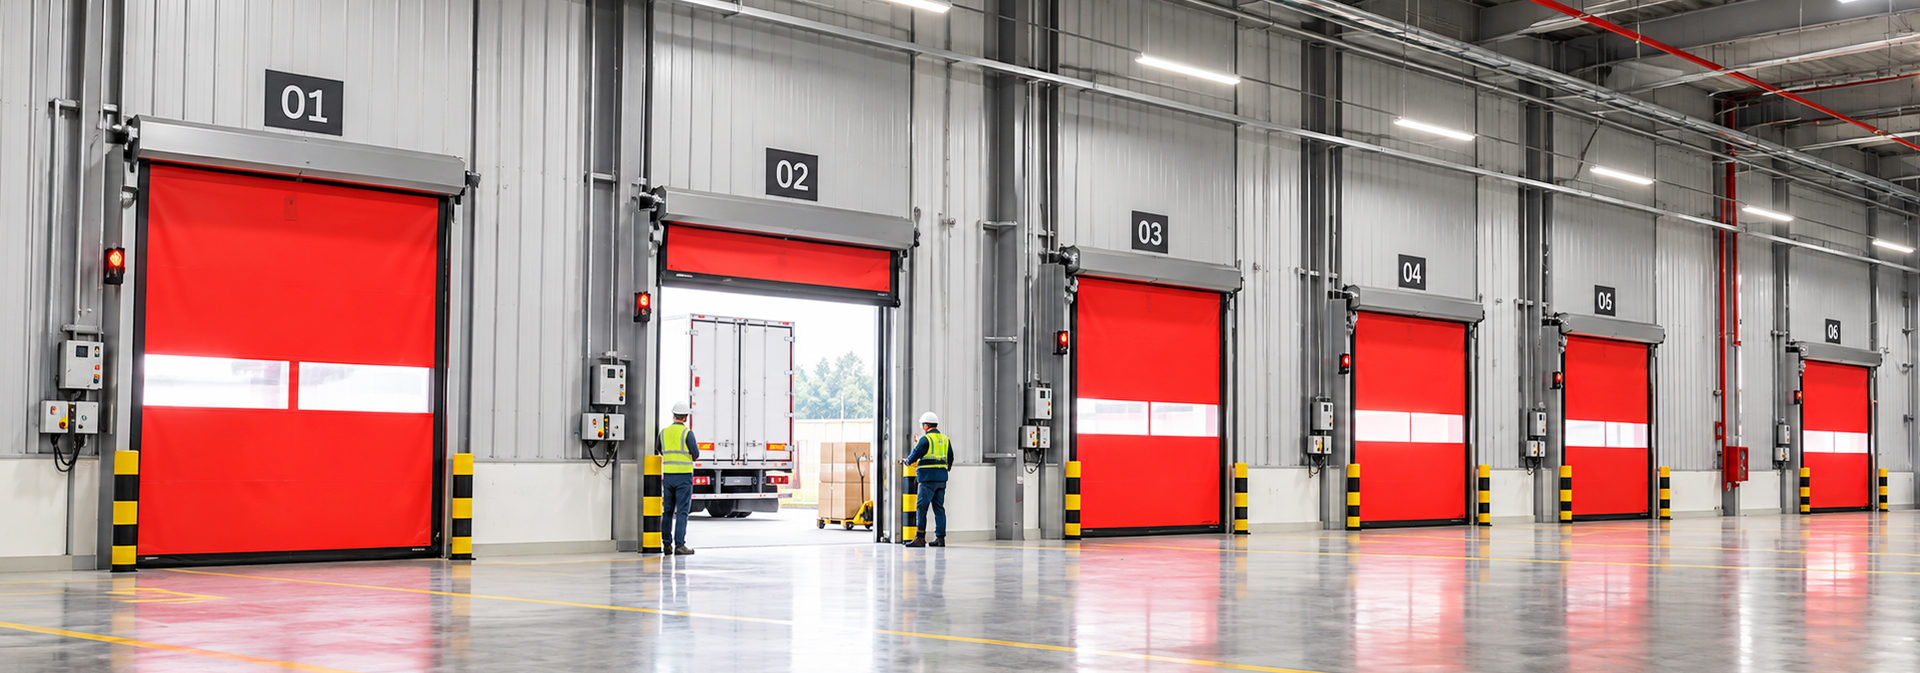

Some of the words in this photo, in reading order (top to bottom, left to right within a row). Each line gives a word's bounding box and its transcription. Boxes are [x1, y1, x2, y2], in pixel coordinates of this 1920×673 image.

[281, 84, 328, 124] 01
[776, 159, 809, 191] 02
[1138, 219, 1162, 246] 03
[1403, 261, 1422, 284] 04
[1827, 323, 1839, 340] 06
